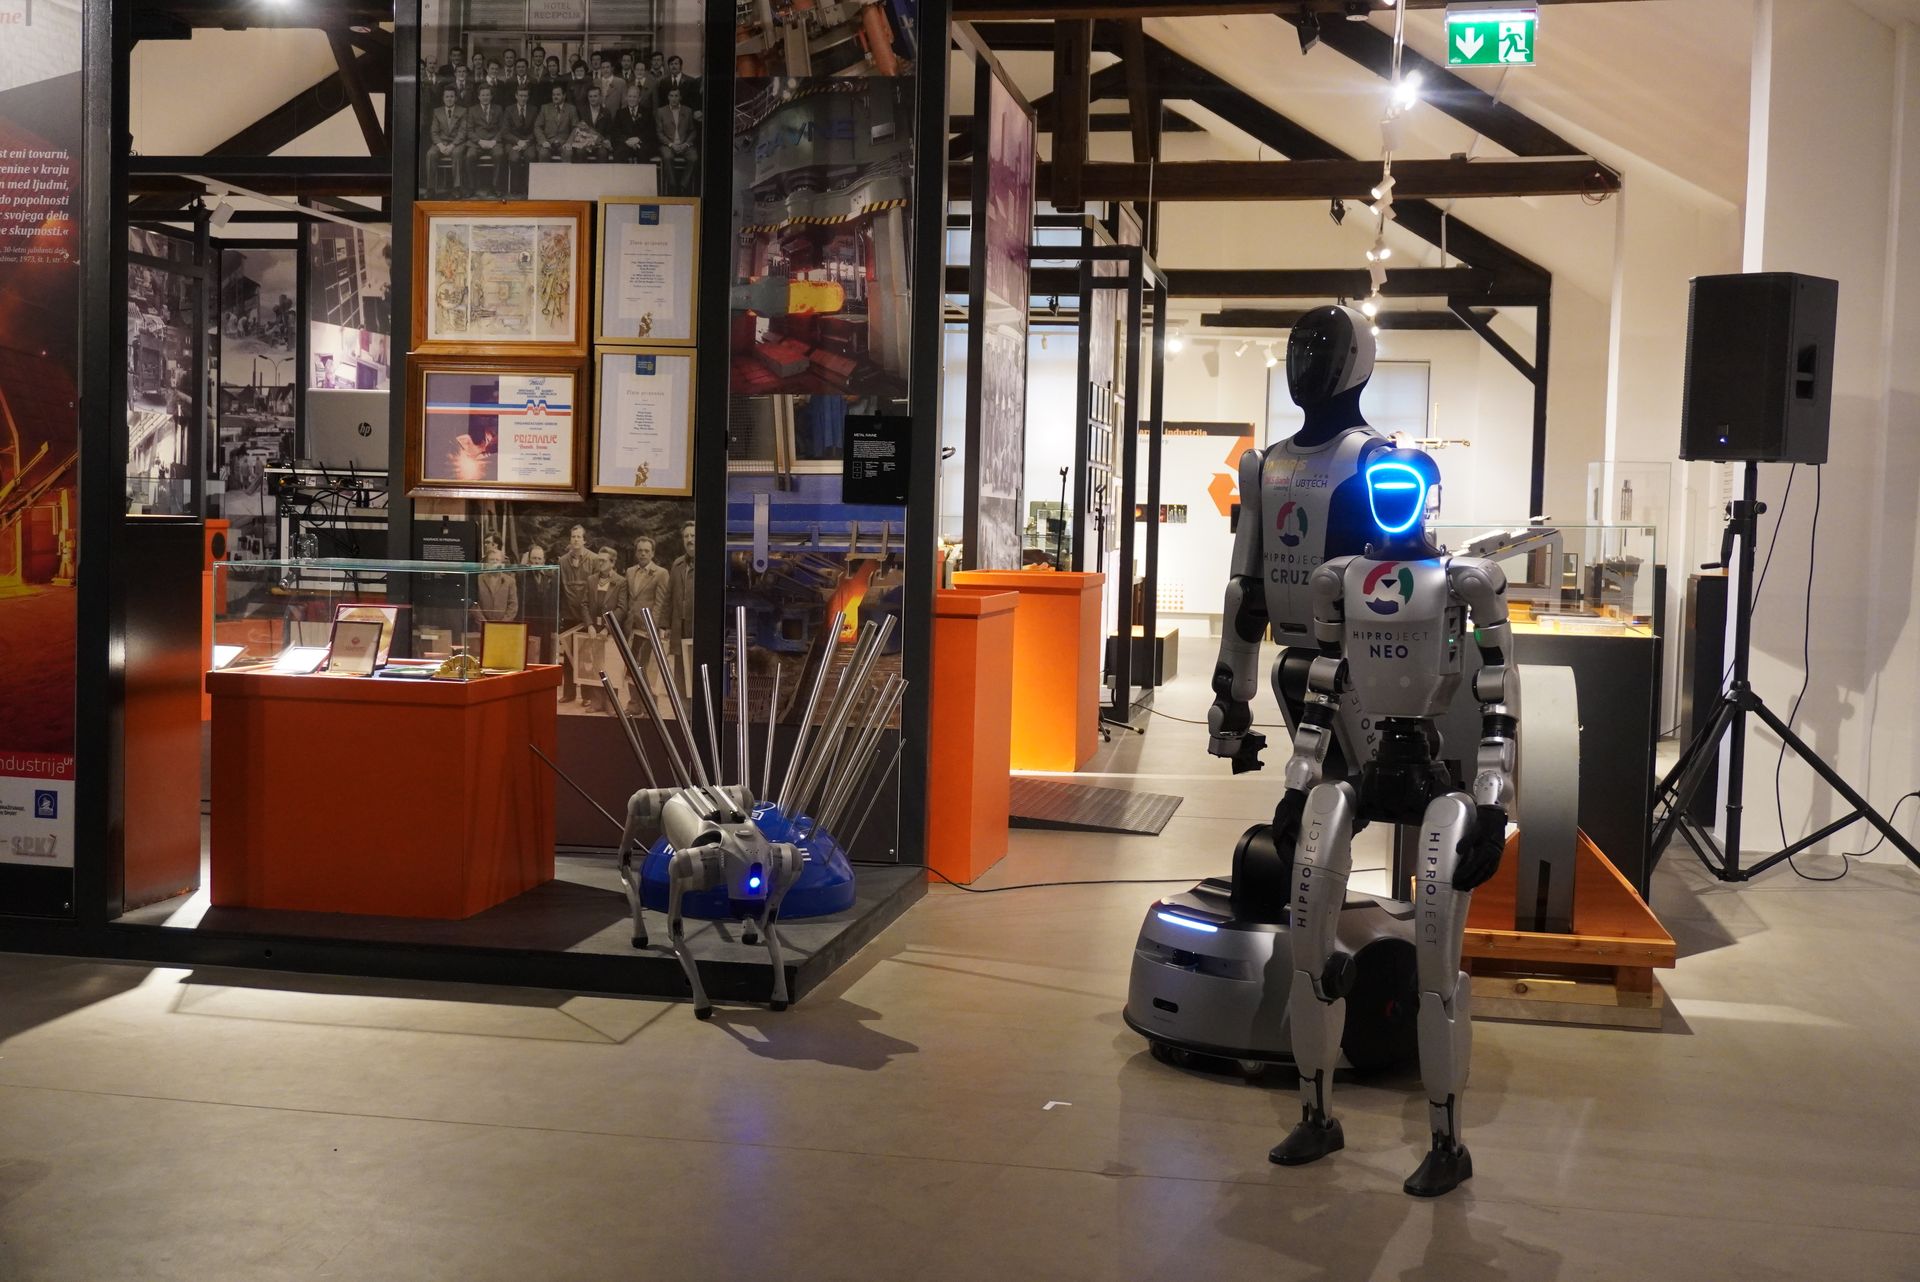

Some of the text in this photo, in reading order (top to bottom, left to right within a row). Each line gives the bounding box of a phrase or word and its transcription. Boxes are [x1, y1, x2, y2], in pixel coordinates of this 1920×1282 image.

[10, 149, 26, 159] eni
[28, 150, 69, 161] tovarni,
[41, 164, 69, 177] kraju
[7, 179, 30, 190] med
[32, 179, 69, 192] ljudmi,
[13, 195, 69, 207] popolnosti
[4, 210, 69, 222] svojega dela
[9, 225, 69, 238] skupnosti.«
[358, 422, 372, 438] hp
[1295, 479, 1328, 489] UBTECH
[1352, 631, 1428, 641] HIPROJECT
[1369, 645, 1409, 659] NEO
[1297, 819, 1322, 928] HIPROJECT
[1425, 832, 1441, 945] HIPROJECT
